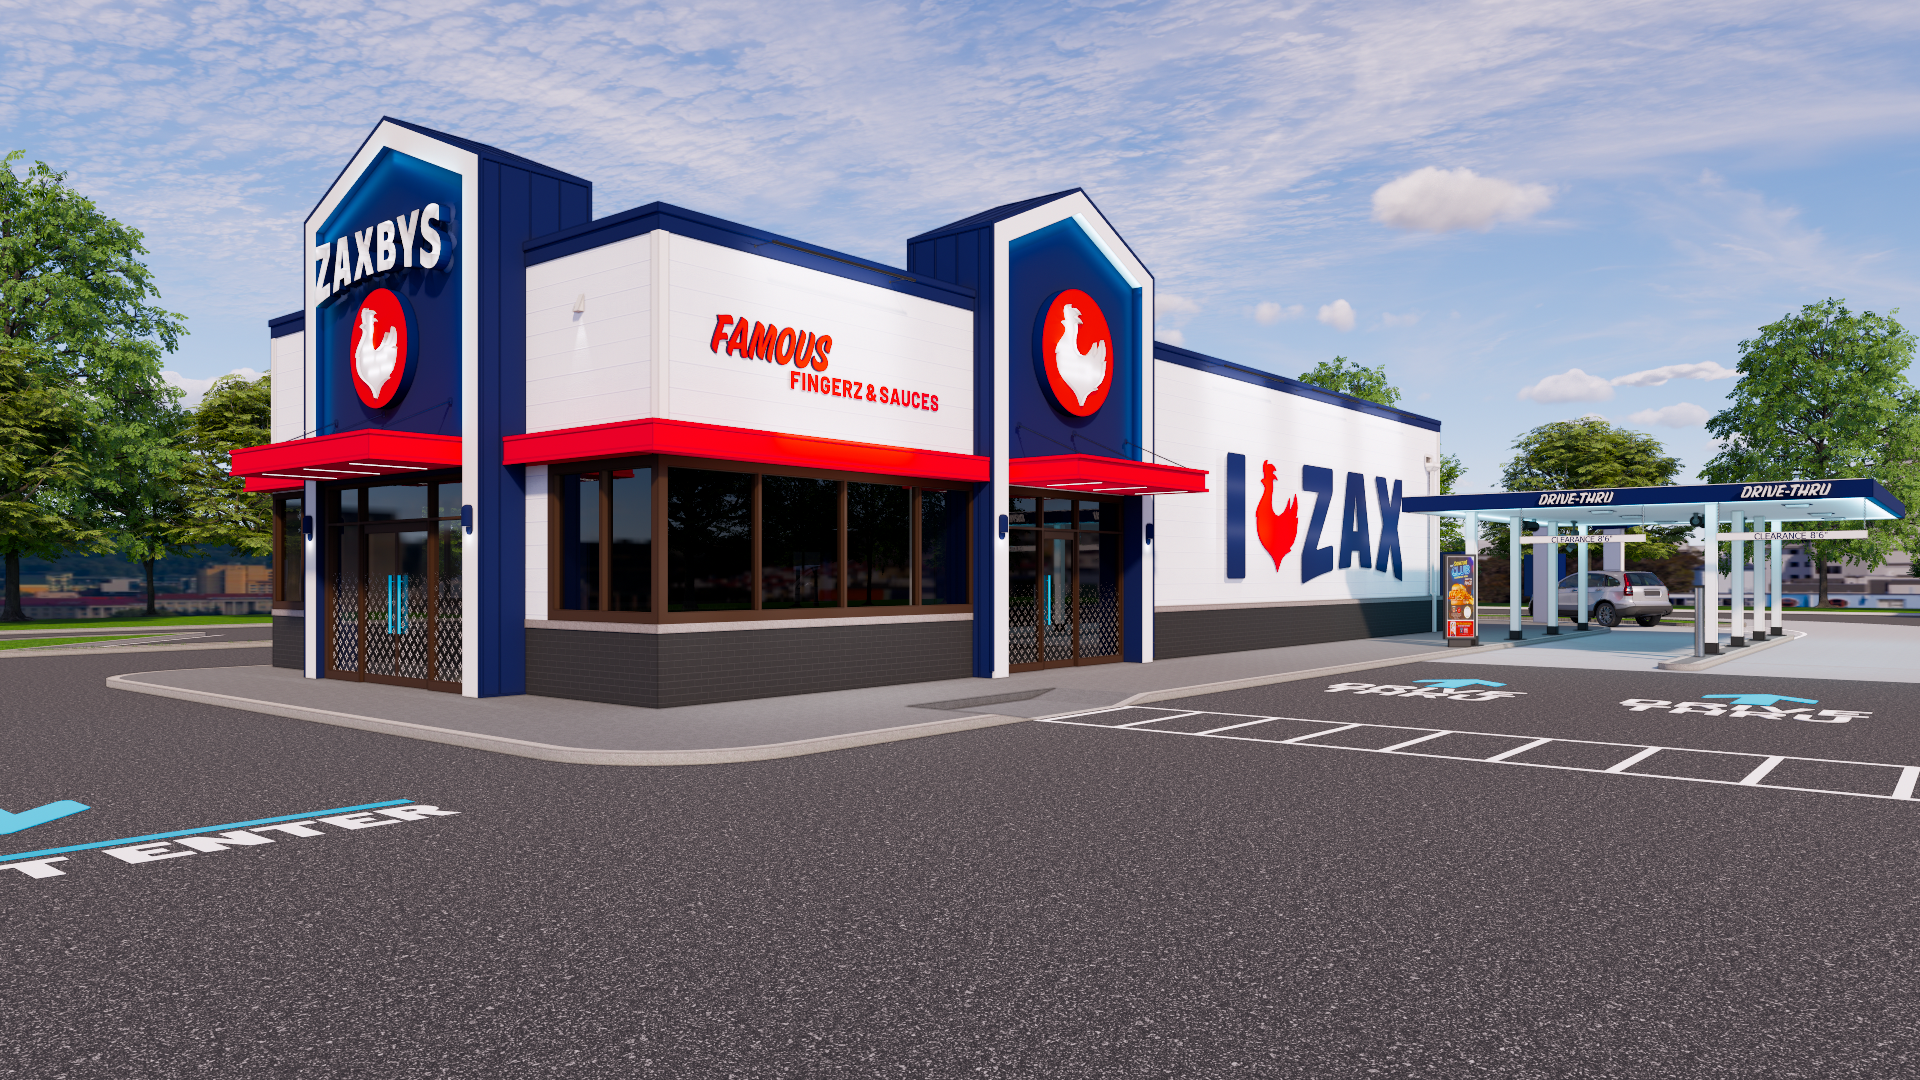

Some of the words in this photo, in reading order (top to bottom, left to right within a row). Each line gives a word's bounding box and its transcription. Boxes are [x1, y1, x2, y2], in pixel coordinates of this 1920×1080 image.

[315, 202, 442, 308] ZAXBYS
[710, 314, 833, 372] FAMOUS
[789, 370, 863, 400] FINGERZ
[865, 383, 878, 403] &
[879, 386, 940, 413] SAUCES
[1538, 491, 1615, 506] DRIVE-THRU
[1740, 483, 1833, 499] DRIVE-THRU
[1226, 452, 1246, 580] I
[1301, 464, 1403, 585] ZAX
[1551, 536, 1595, 544] CLEARANCE
[1597, 535, 1613, 543] 8'6"
[1753, 531, 1807, 541] CLEARANCE
[1810, 531, 1829, 540] 8'6"
[101, 804, 462, 865] ENTER
